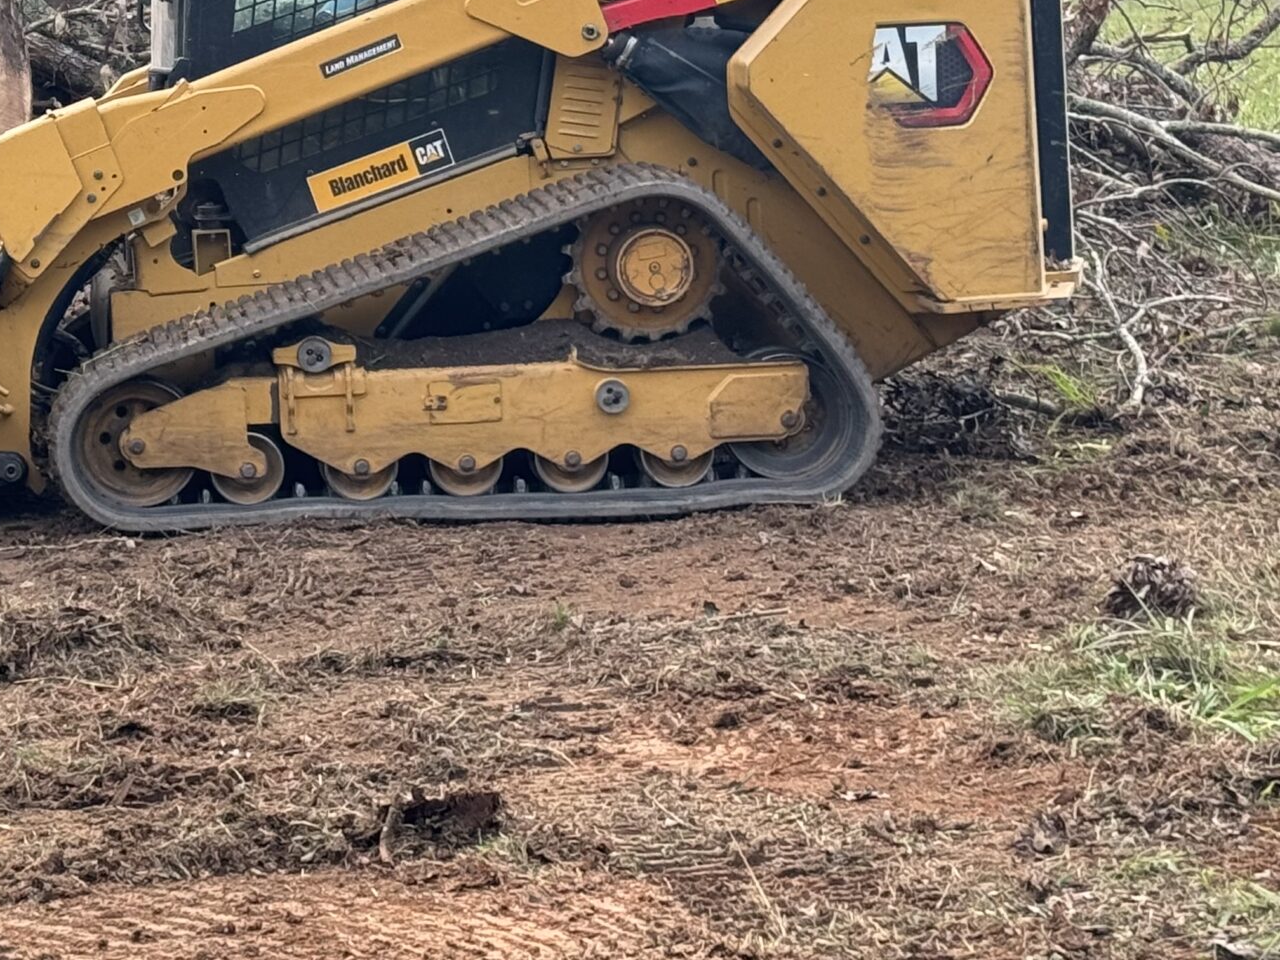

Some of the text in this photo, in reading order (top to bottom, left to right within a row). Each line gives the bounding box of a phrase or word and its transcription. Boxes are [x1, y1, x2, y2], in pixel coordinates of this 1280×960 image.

[867, 25, 948, 102] AT
[328, 139, 446, 197] Blanchard CAT
